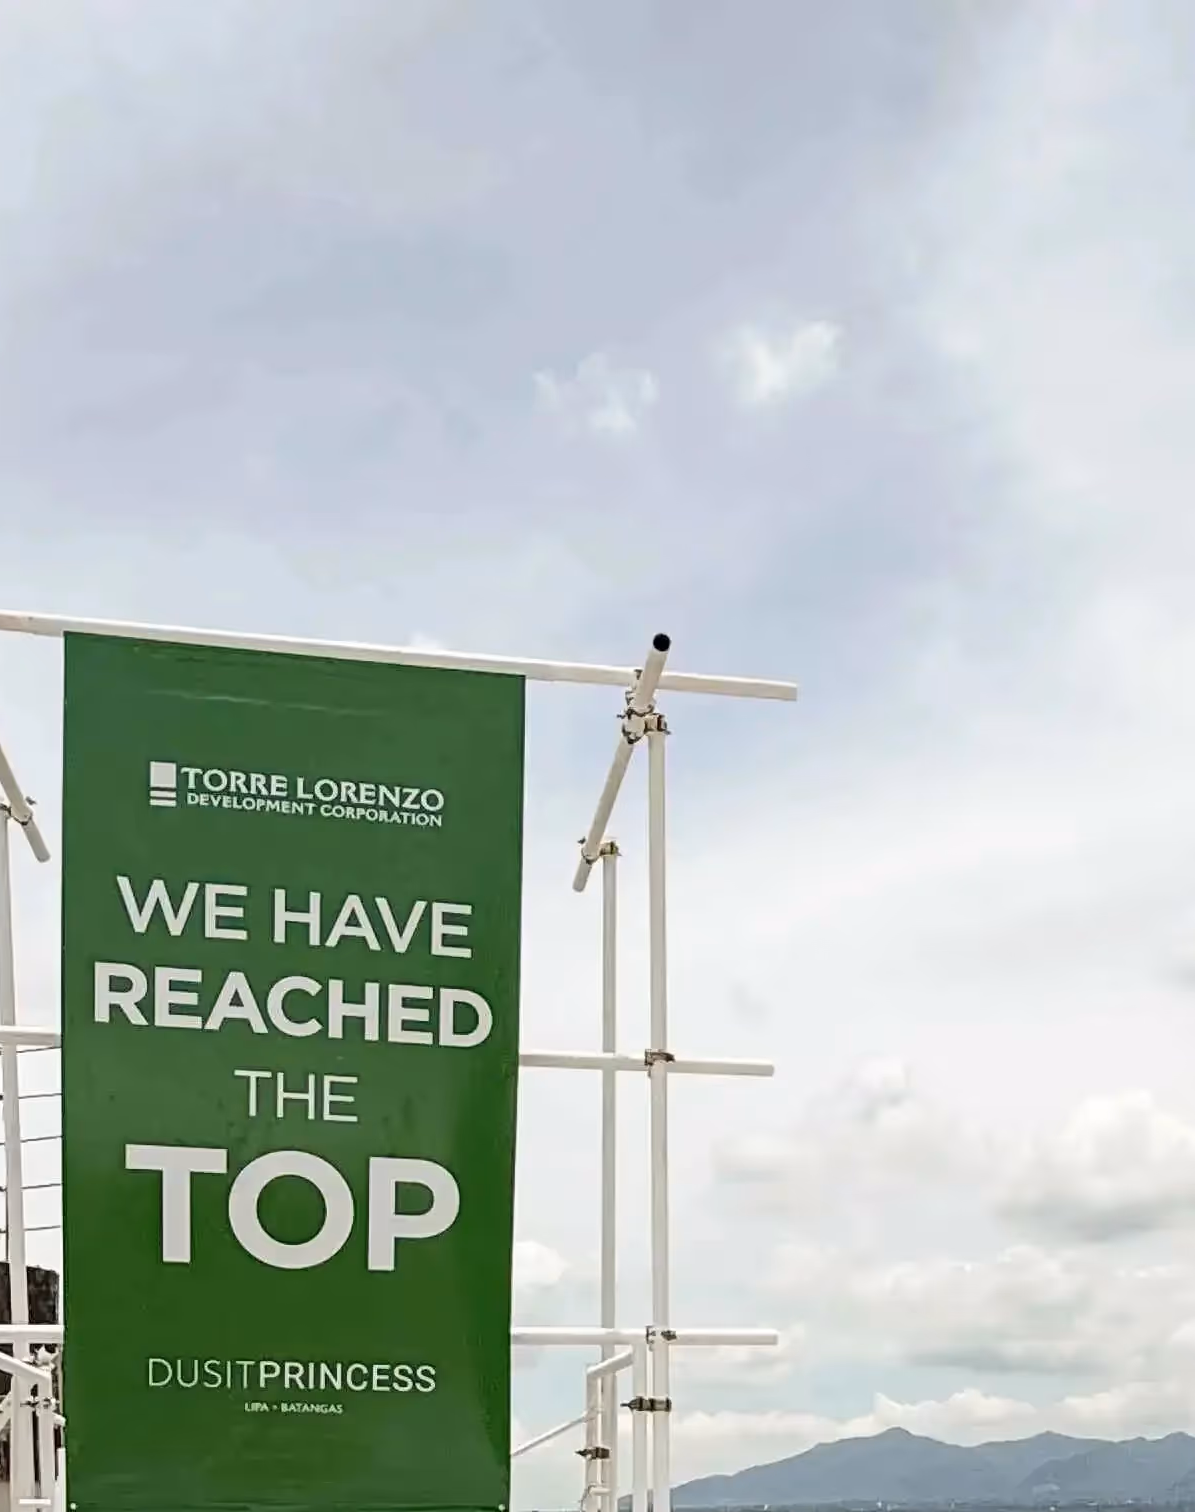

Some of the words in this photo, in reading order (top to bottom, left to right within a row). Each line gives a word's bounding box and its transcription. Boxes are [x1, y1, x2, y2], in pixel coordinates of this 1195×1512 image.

[181, 766, 288, 798] TORRE
[297, 777, 445, 812] LORENZO
[186, 792, 316, 816] DEVELOPMENT
[320, 803, 443, 828] CORPORATION
[116, 875, 248, 941] WE
[273, 888, 473, 959] HAVE
[93, 961, 493, 1048] REACHED
[233, 1069, 359, 1122] THE
[124, 1143, 460, 1272] TOP
[148, 1358, 436, 1392] DUSITPRINCESS
[281, 1402, 344, 1415] BATANGAS
